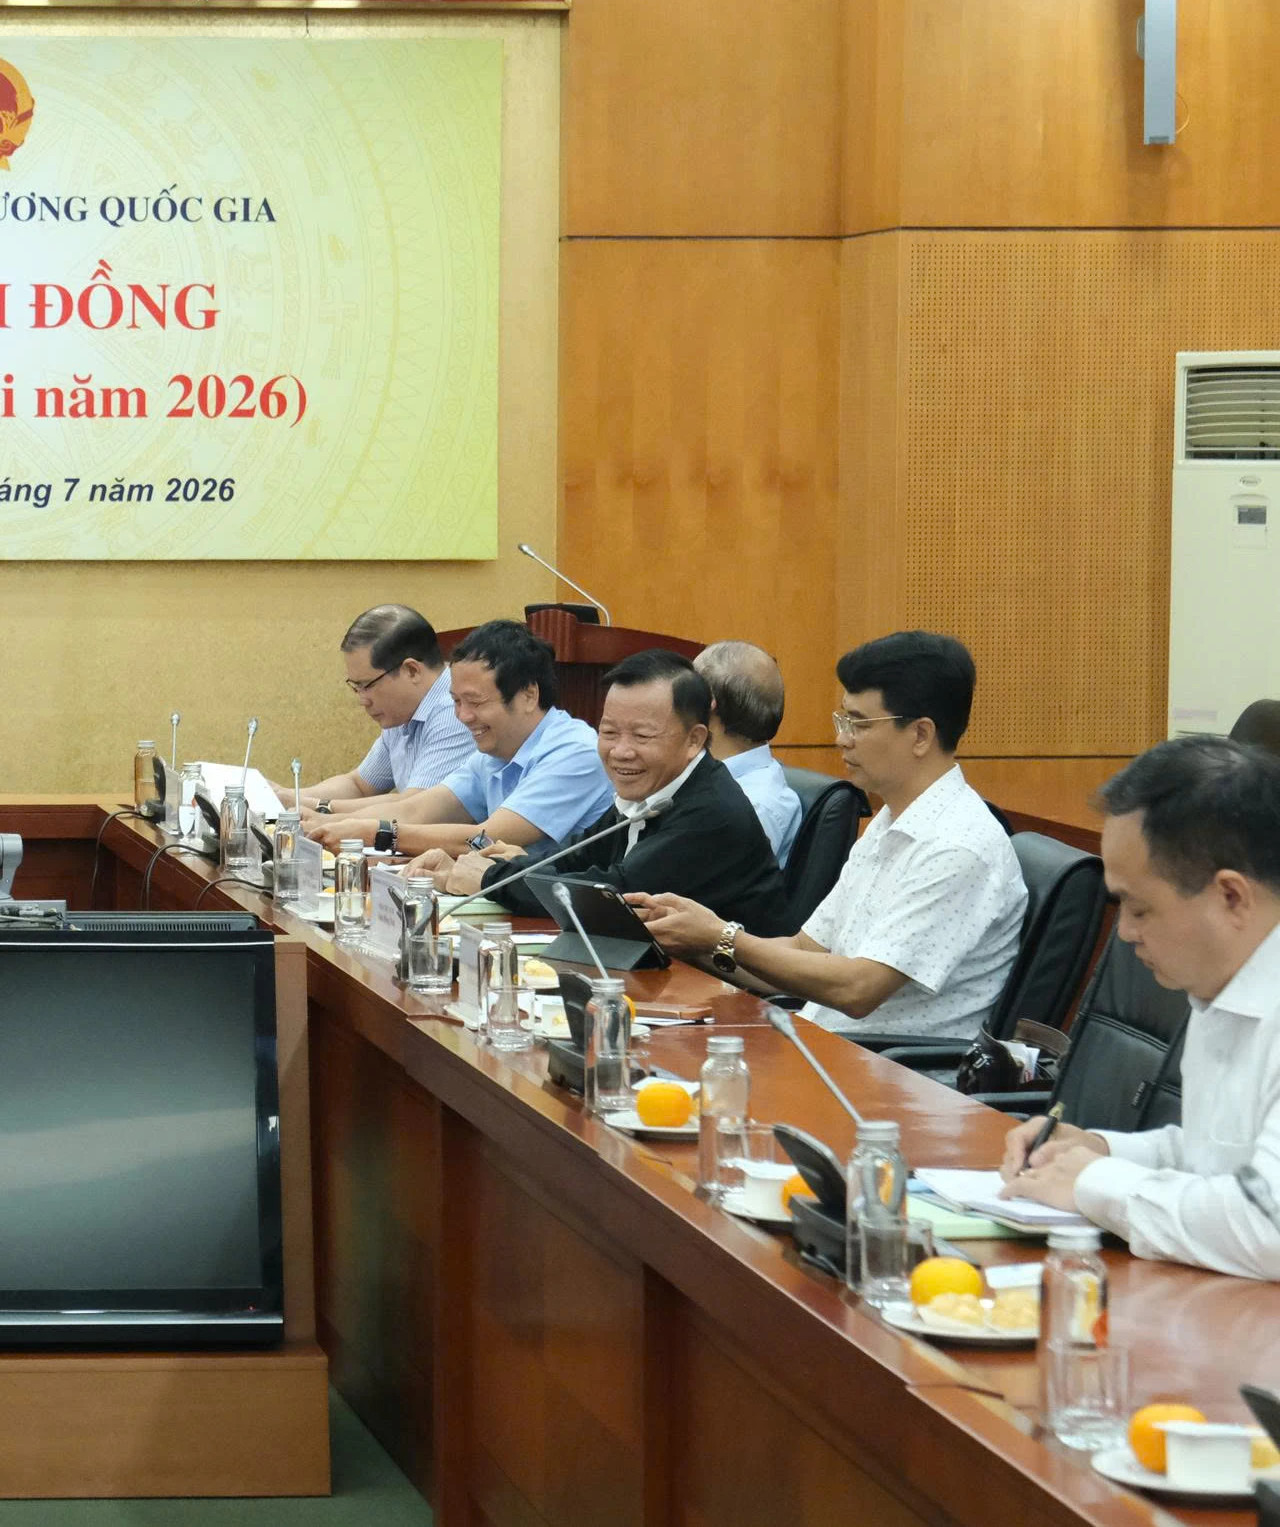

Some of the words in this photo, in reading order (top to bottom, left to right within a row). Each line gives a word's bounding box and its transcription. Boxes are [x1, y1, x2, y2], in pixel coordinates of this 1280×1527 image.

[99, 184, 203, 229] QUỐC
[213, 197, 277, 223] GIA
[29, 260, 220, 331] ĐỒNG
[34, 374, 148, 420] năm
[166, 374, 308, 427] 2026)
[64, 478, 81, 502] 7
[88, 476, 154, 502] năm
[165, 478, 236, 502] 2026
